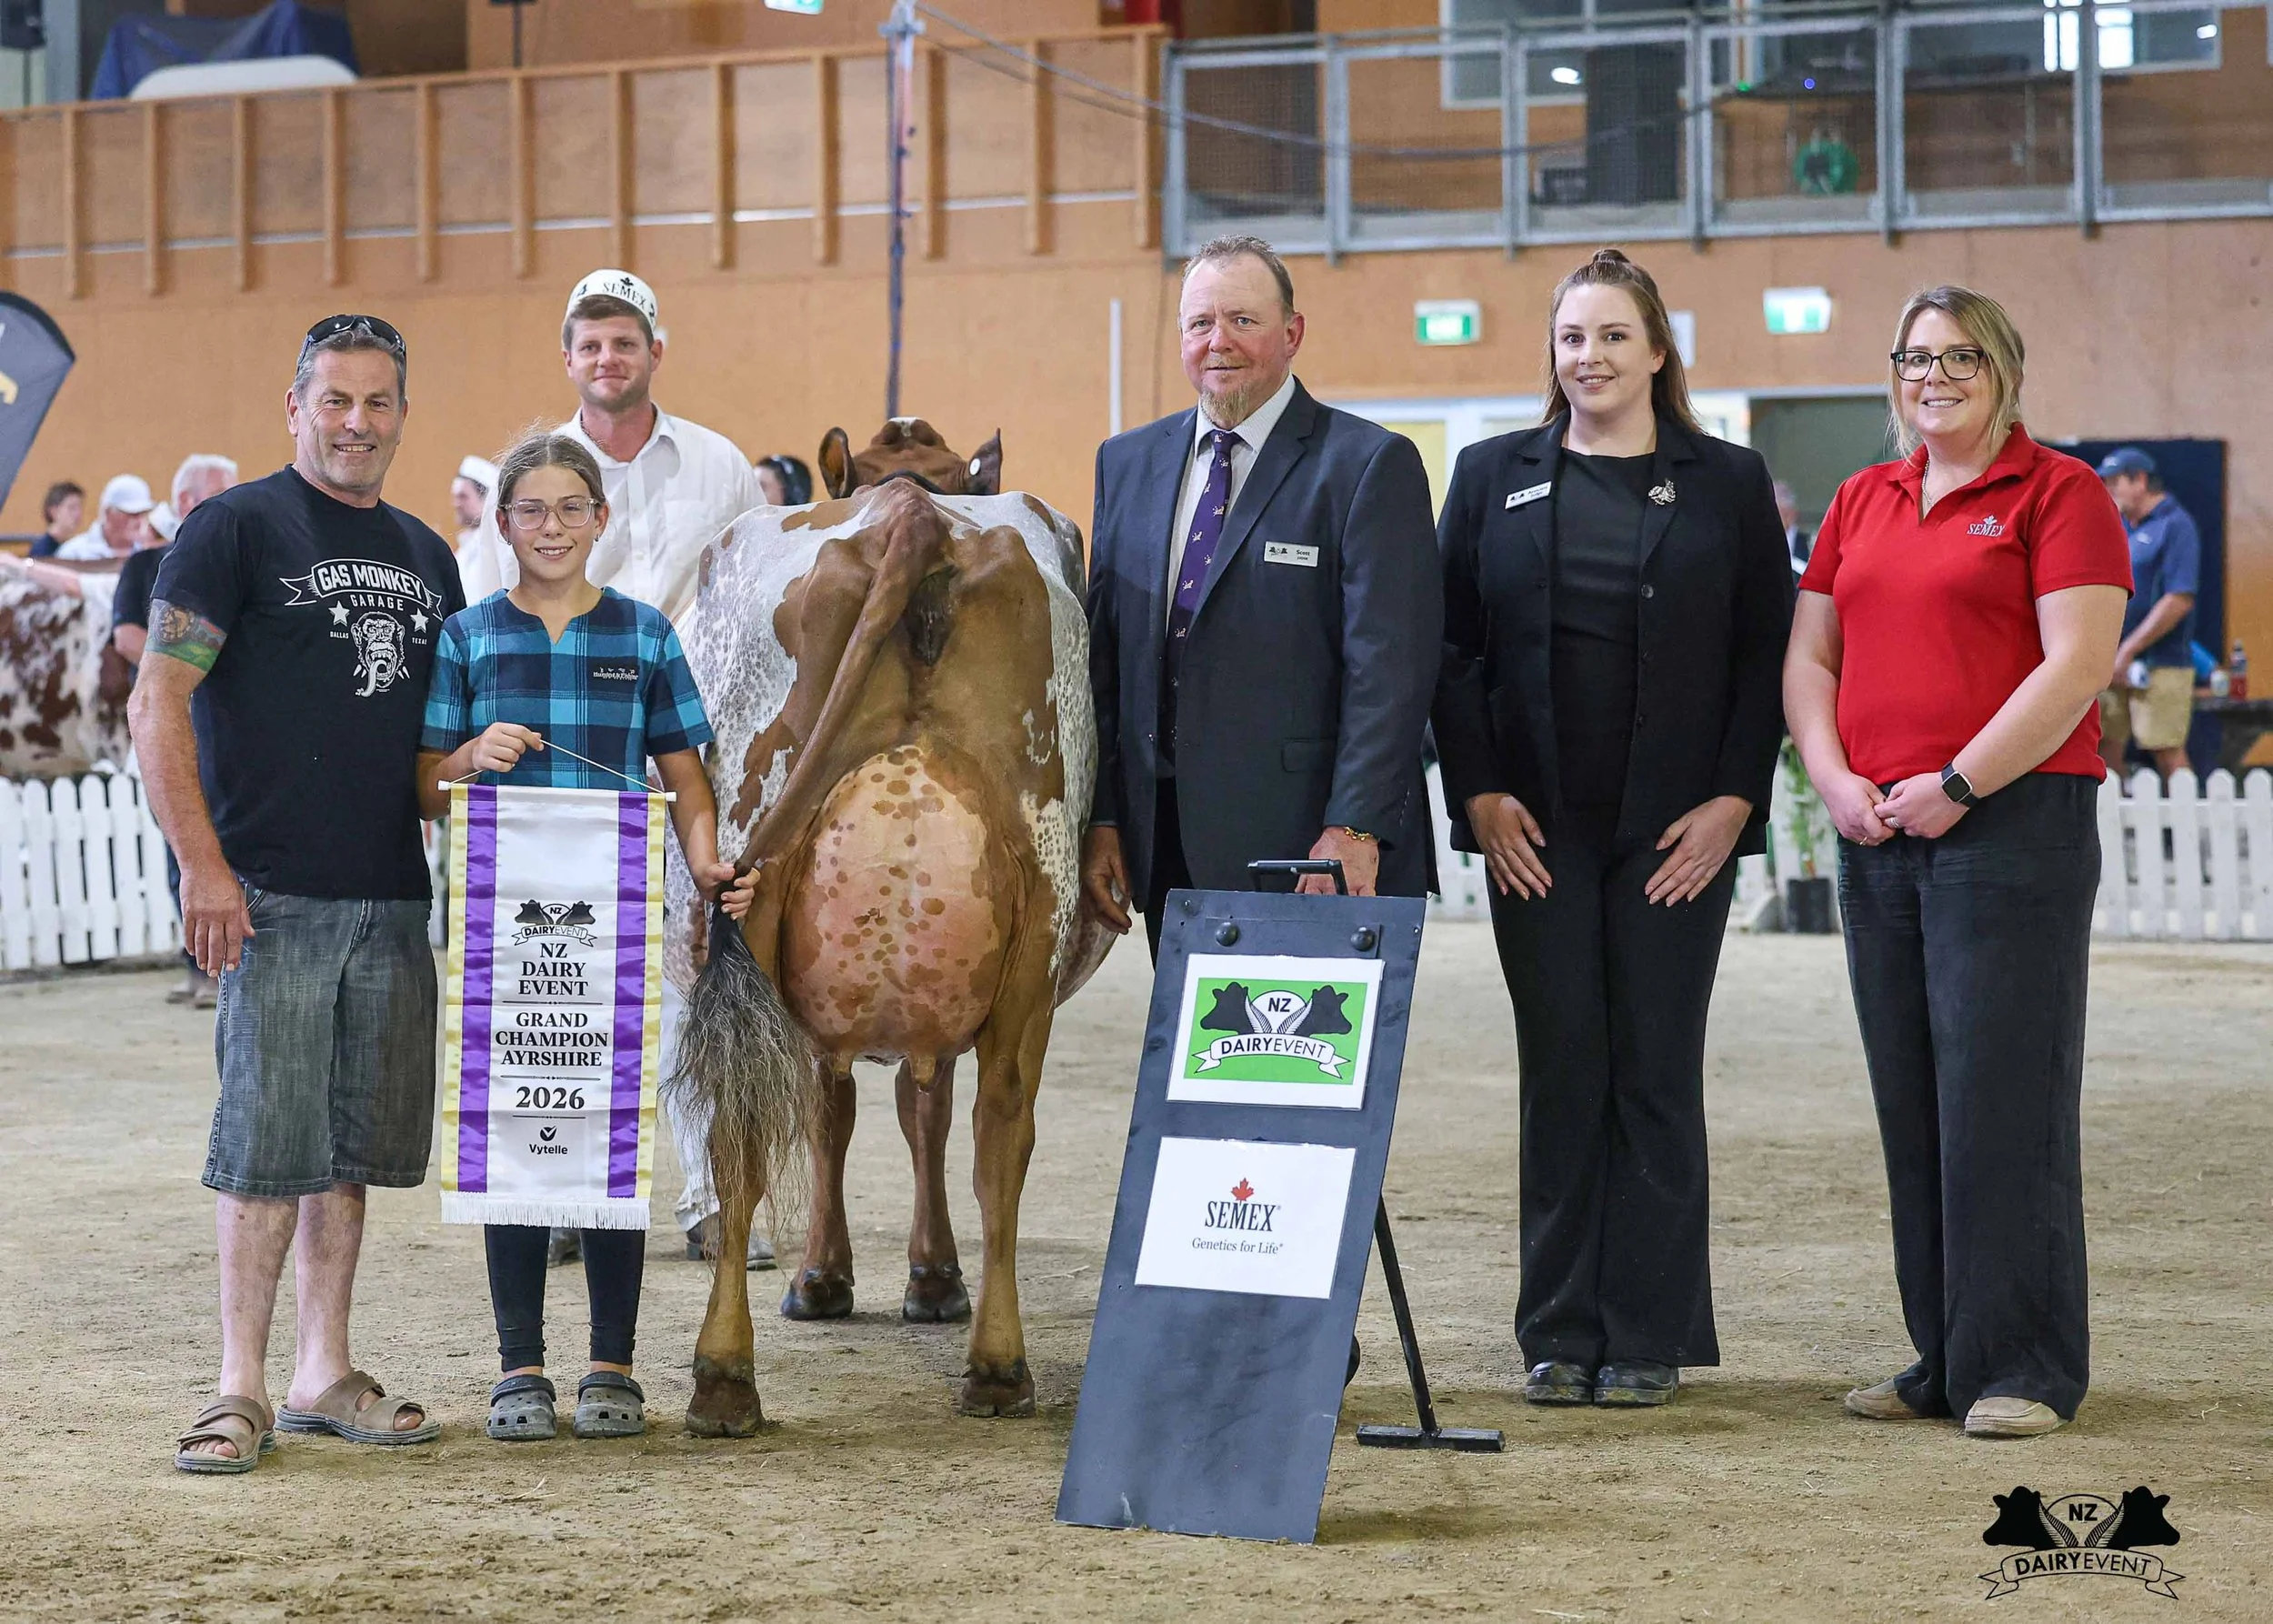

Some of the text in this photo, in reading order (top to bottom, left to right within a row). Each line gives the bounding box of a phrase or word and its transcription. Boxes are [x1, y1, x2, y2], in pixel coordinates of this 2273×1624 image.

[603, 283, 646, 309] SEMEX
[1967, 523, 2007, 537] SEMEX
[317, 564, 422, 600] GAS MONKEY
[350, 594, 405, 612] GARAGE
[329, 631, 349, 639] DALLAS
[549, 907, 563, 916] NZ
[539, 942, 568, 958] NZ
[521, 961, 586, 977] DAIRY
[517, 979, 589, 997] EVENT
[1267, 997, 1292, 1013] NZ
[516, 1012, 588, 1028] GRAND
[495, 1030, 609, 1048] CHAMPION
[501, 1050, 602, 1067] AYRSHIRE
[515, 1086, 586, 1109] 2026
[528, 1143, 568, 1156] Vytelle
[1191, 1237, 1237, 1252] Genetics
[1239, 1239, 1257, 1254] for
